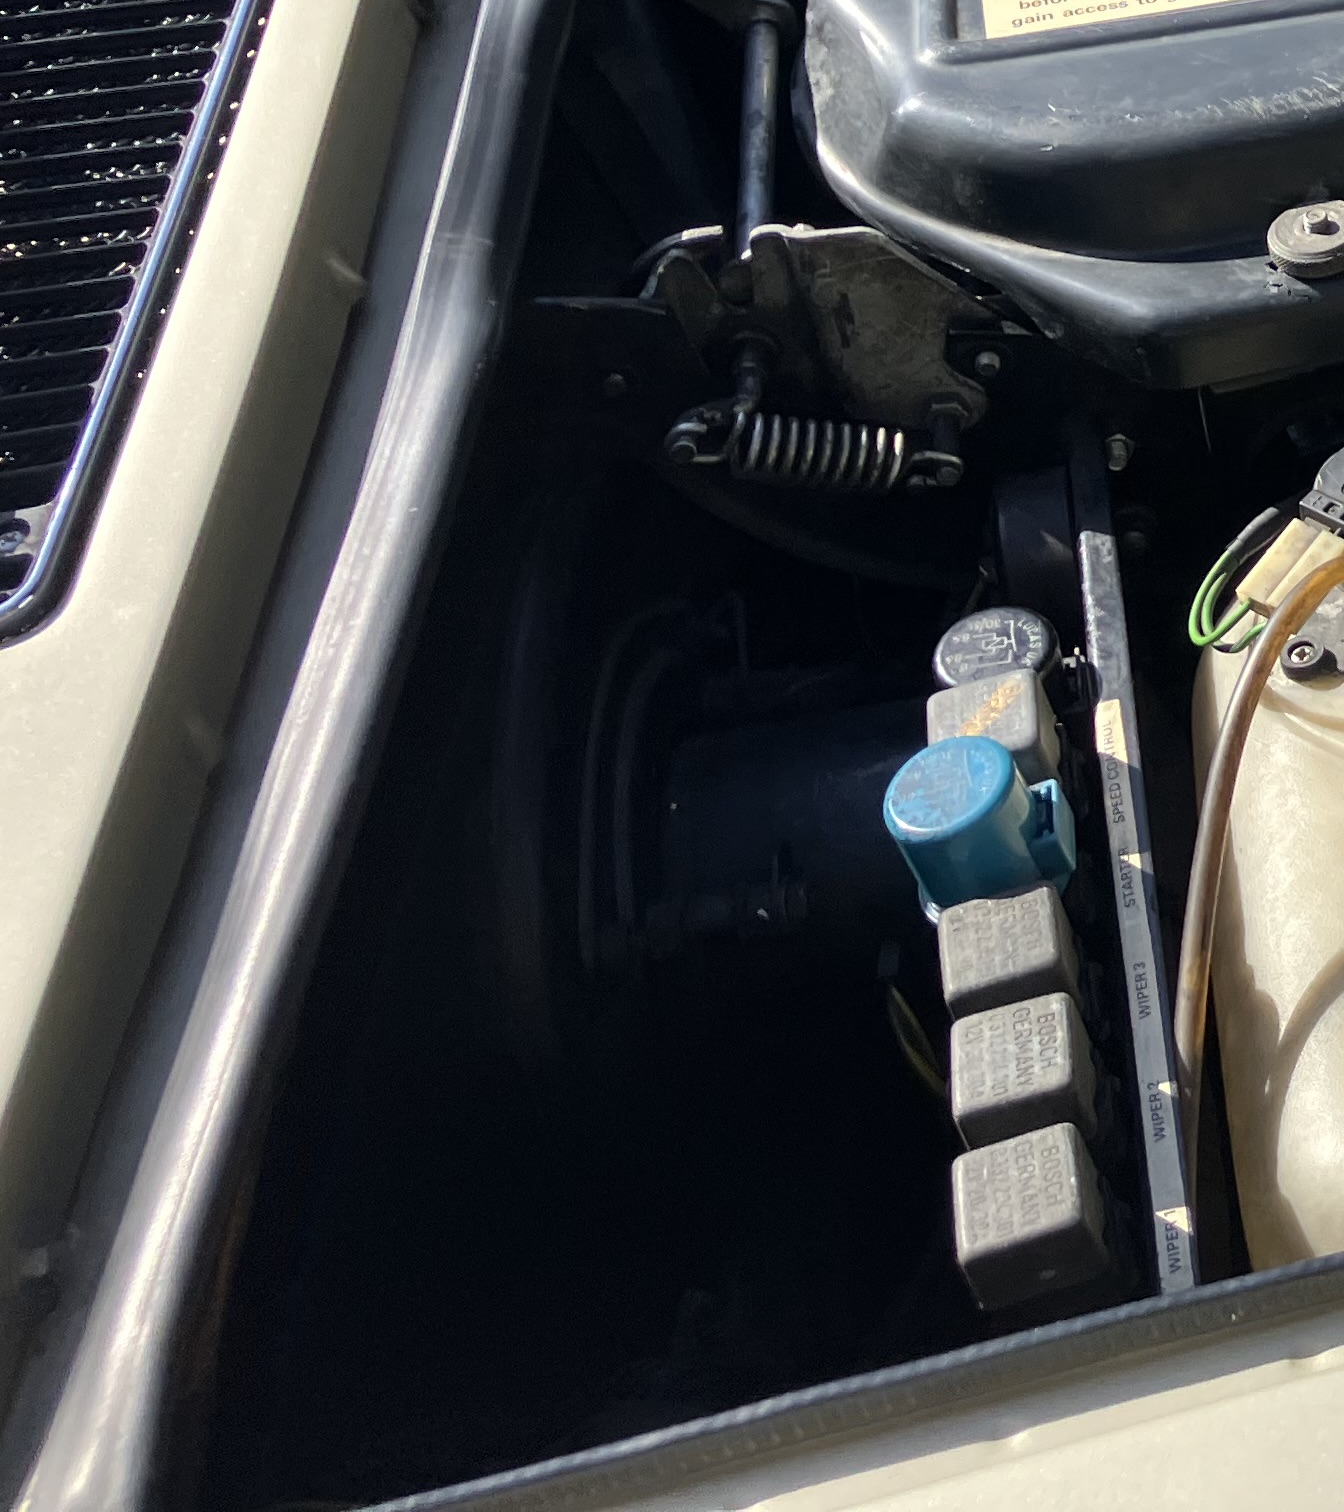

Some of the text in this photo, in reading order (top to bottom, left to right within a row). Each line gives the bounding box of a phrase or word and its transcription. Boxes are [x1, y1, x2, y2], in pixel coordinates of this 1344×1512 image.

[1011, 11, 1054, 28] gain
[1017, 619, 1042, 649] LUCAS
[1102, 719, 1126, 824] SPEED CONTROL
[1118, 847, 1136, 909] STARTER
[1021, 898, 1043, 951] BOSCH
[1134, 961, 1151, 1020] WIPER 3
[1013, 1007, 1035, 1089] GERMANY
[1037, 1012, 1058, 1069] BOSCH
[1147, 1081, 1166, 1143] WIPER 2
[1015, 1141, 1040, 1226] GERMANY
[1041, 1145, 1066, 1207] BOSCH
[1165, 1220, 1181, 1275] WIPER
